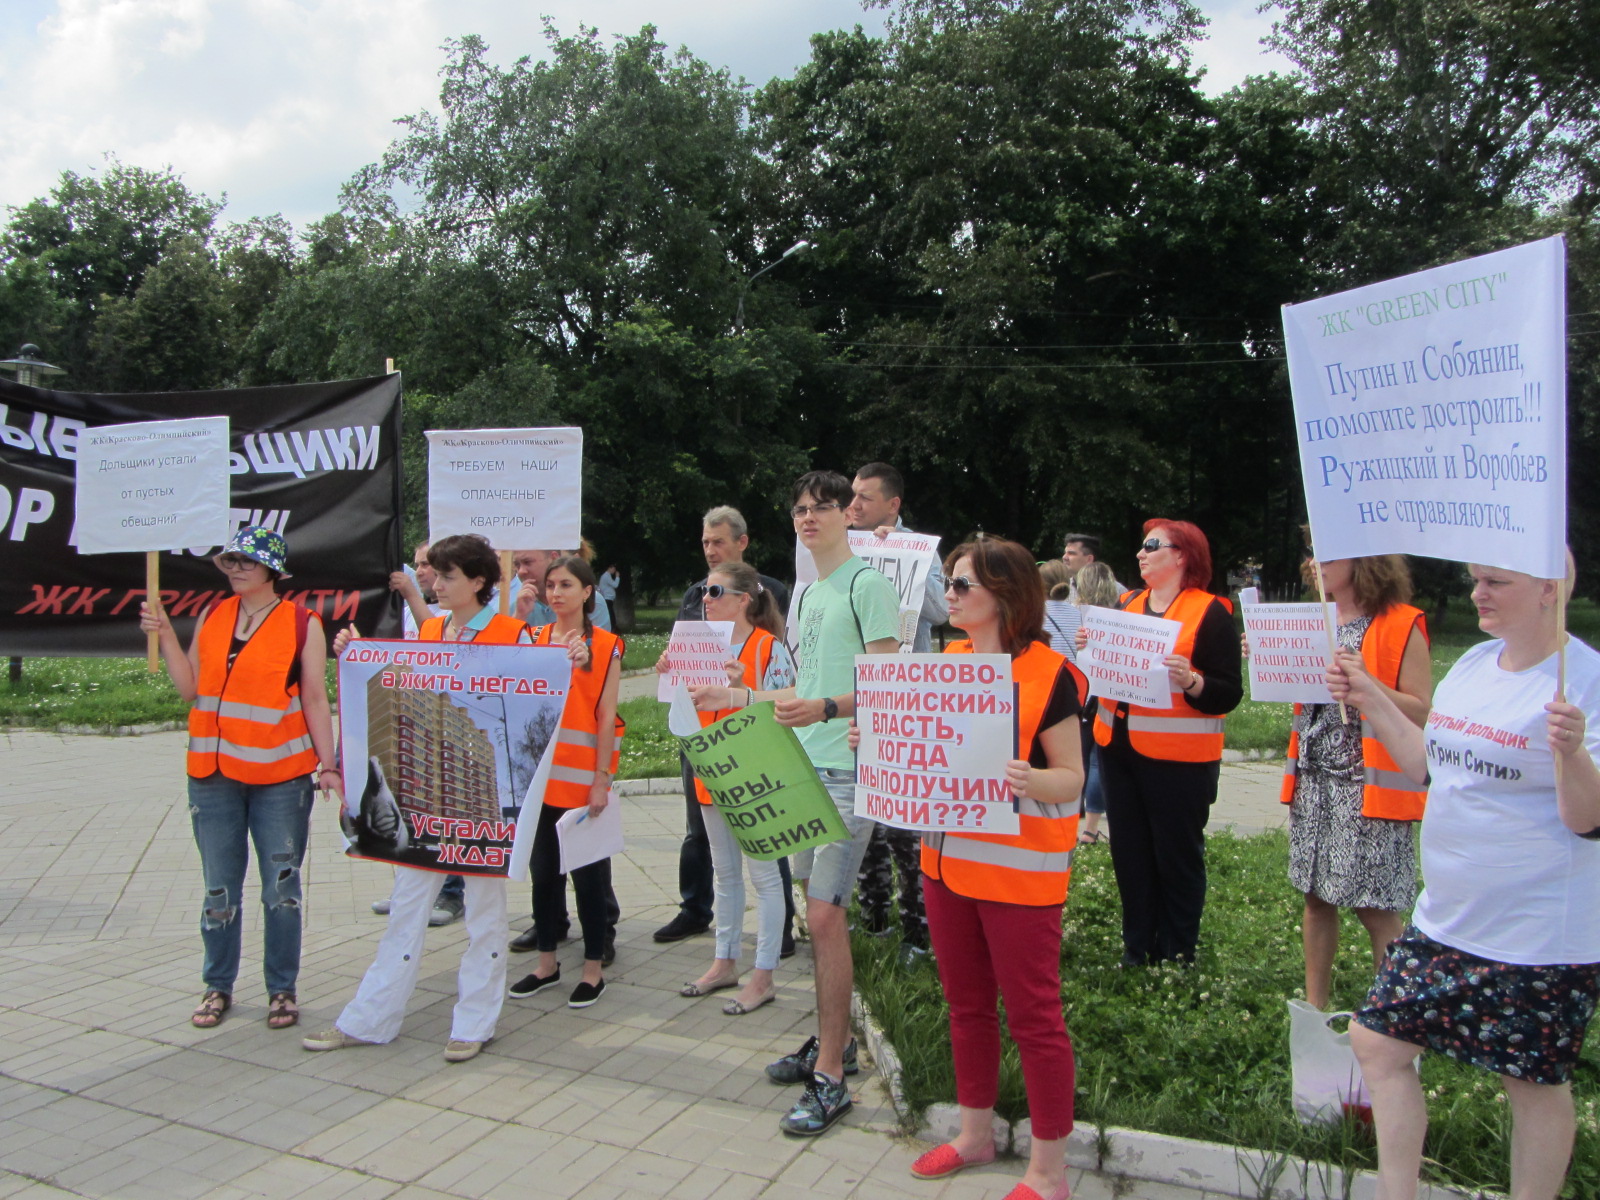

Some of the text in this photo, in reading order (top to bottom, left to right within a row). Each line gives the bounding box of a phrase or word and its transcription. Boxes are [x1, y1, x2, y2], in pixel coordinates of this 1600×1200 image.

[1317, 271, 1510, 337] ЖК "GREEN CITY"
[1324, 339, 1525, 402] Путин и Собянин,
[1304, 381, 1542, 442] помогите достроить!!!
[99, 454, 197, 472] Дольщики устали
[449, 460, 558, 472] ТРЕБУЕМ НАШИ
[1318, 441, 1548, 493] Ружицкий и Воробьев
[121, 487, 175, 500] от пустых
[461, 489, 546, 500] ОПЛАЧЕННЫЕ
[121, 514, 177, 528] обещаний
[470, 517, 535, 527] КВАРТИРЫ
[1357, 499, 1525, 534] не справляются...
[848, 537, 932, 553] КОВО-ОЛИМПИЙСКИЙ»
[14, 584, 111, 615] ЖК
[109, 589, 227, 616] ГРИ
[1253, 605, 1323, 614] КРАСКОВО-ОЛИМПИЙСКИ
[1246, 619, 1325, 632] МОШЕННИКИ
[690, 643, 725, 654] АЛИНА-
[1106, 632, 1167, 655] ДОЛЖЕН
[1257, 636, 1315, 651] ЖИРУЮТ,
[1091, 647, 1150, 671] СИДЕТЬ В
[1254, 654, 1326, 668] НАШИ ДЕТИ
[671, 675, 727, 687] ПРАМИДА!
[858, 662, 1004, 685] ЖК«КРАСКОВО-
[1089, 664, 1148, 689] ТЮРЬМЕ!
[1256, 671, 1325, 685] БОМЖУЮТ
[857, 688, 1012, 715] ОЛИМПИЙСКИЙ»
[1109, 687, 1156, 704] Глеб Жиглов
[872, 711, 964, 746] ВЛАСТЬ,
[878, 738, 949, 771] КОГДА
[1426, 739, 1522, 781] «Грин Сити»
[725, 802, 786, 830] ДОП.
[867, 793, 987, 827] КЛЮЧИ???
